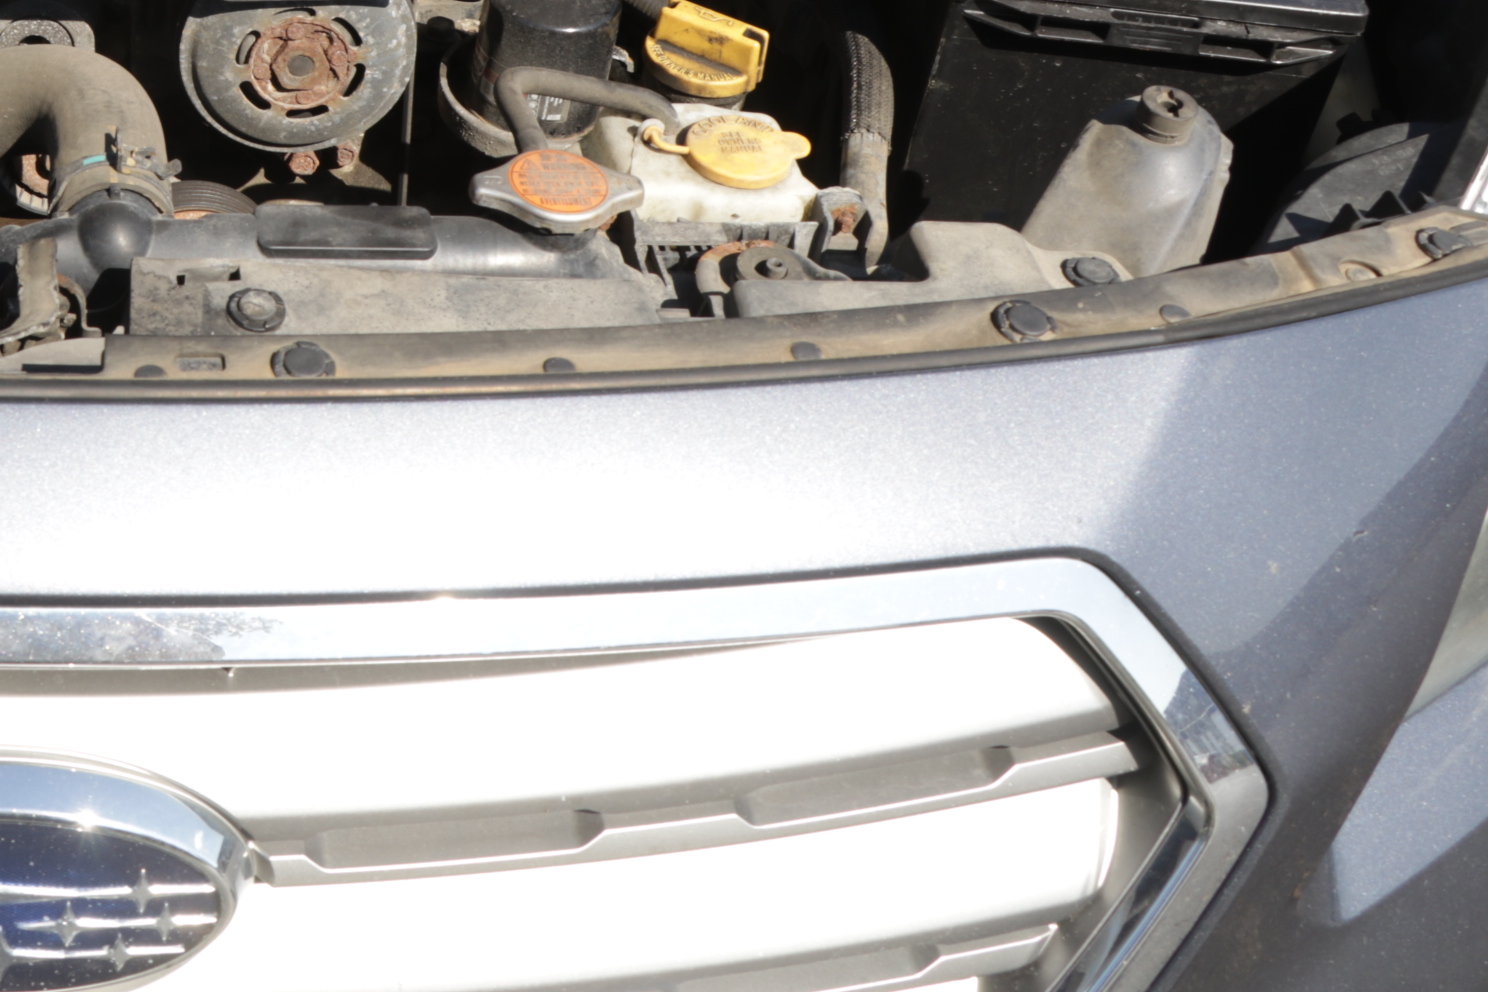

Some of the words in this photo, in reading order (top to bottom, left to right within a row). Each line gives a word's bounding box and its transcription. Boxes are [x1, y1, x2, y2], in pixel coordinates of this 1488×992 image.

[651, 44, 665, 55] SEE
[658, 55, 695, 78] OWNER'S
[697, 72, 736, 81] MANUAL
[691, 115, 774, 137] COOLANT
